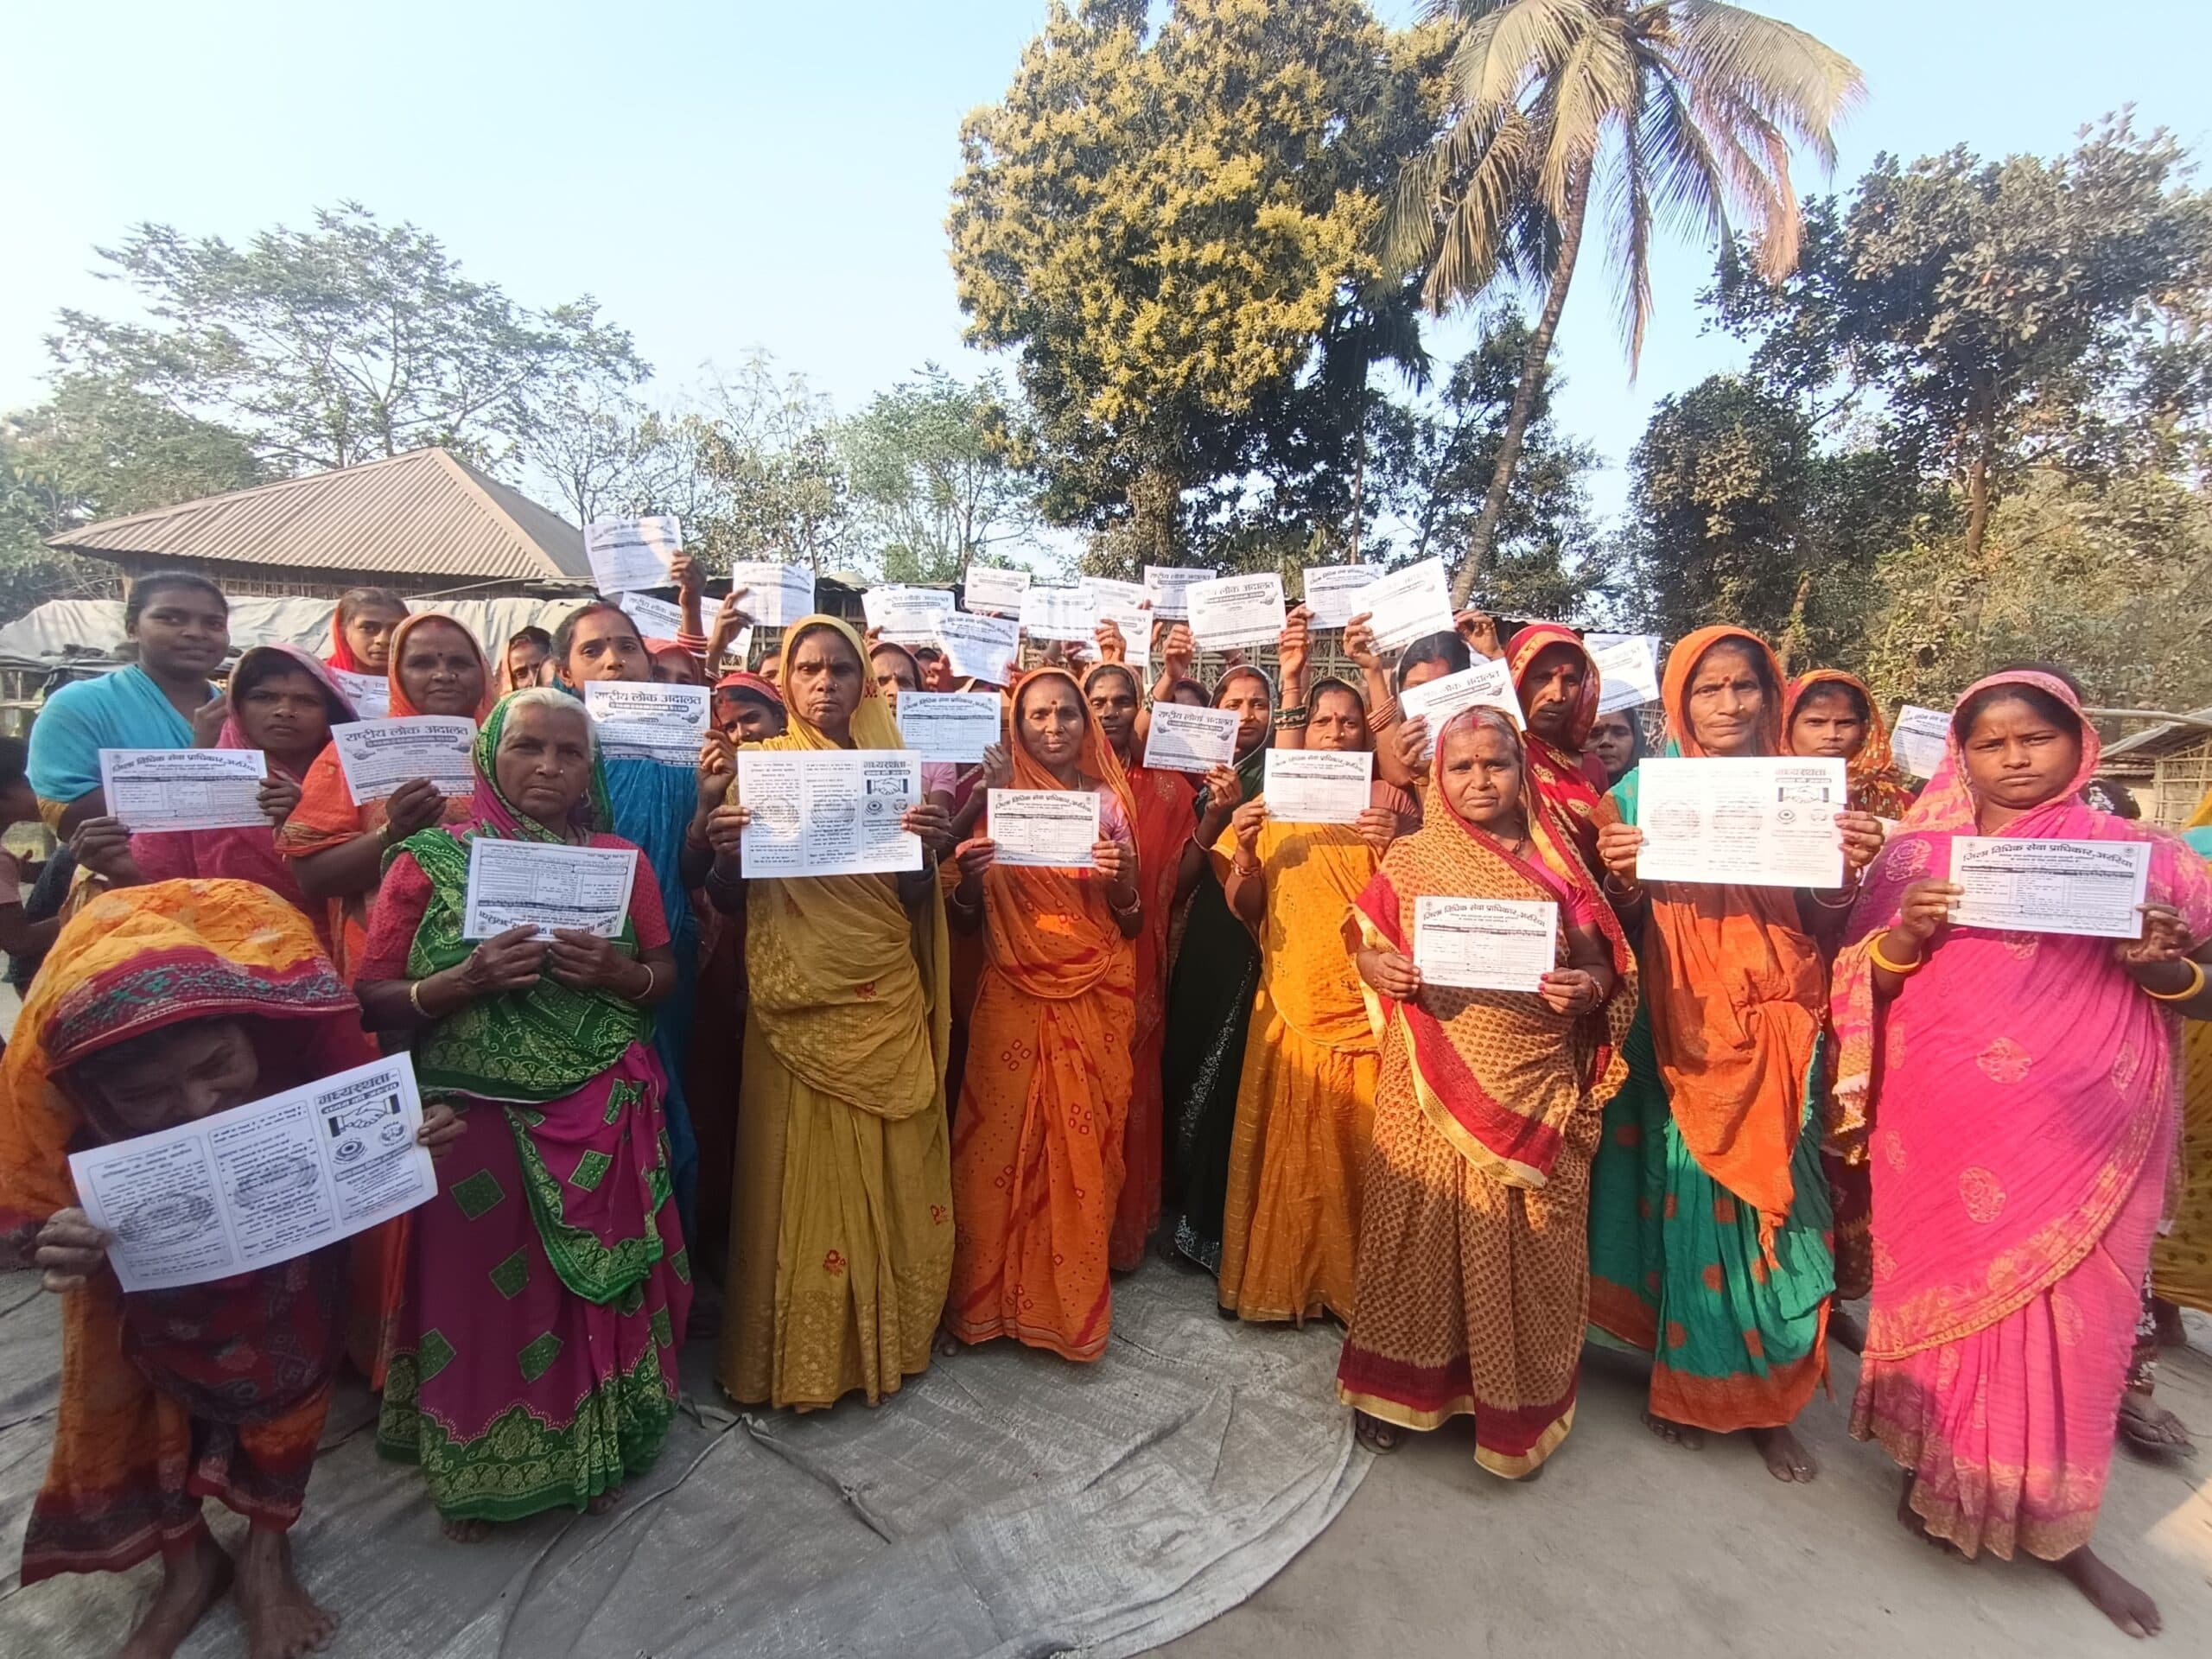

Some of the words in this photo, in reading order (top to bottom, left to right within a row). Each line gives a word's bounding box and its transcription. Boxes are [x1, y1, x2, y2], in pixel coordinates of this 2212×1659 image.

[631, 690, 658, 702] लोक
[660, 694, 702, 705] अदालत
[344, 727, 386, 742] राष्ट्रीय
[389, 725, 420, 737] लोक
[424, 725, 468, 735] अदालत
[1991, 843, 2024, 855] विधिक
[2025, 842, 2046, 852] सेवा
[318, 1071, 390, 1105] मध्यस्थता
